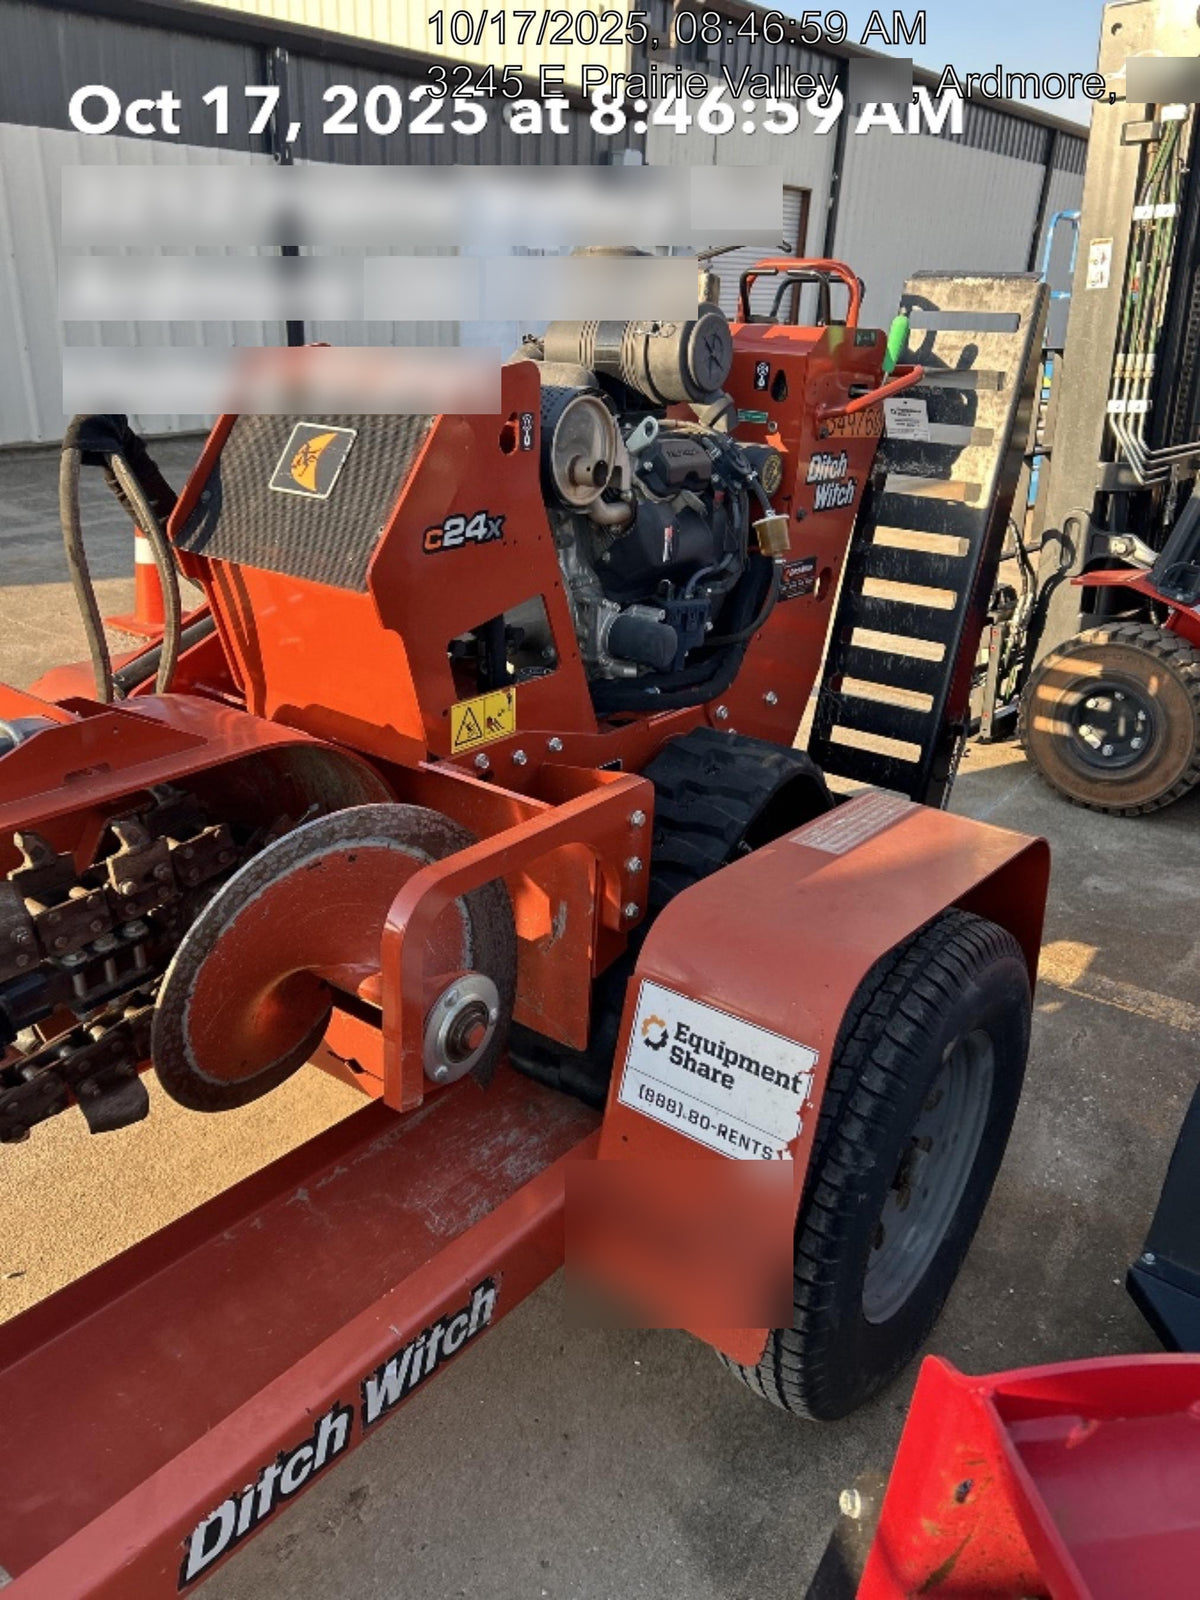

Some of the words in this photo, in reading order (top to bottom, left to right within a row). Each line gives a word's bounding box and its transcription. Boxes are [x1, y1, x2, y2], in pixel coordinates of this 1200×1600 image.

[807, 452, 847, 482] Ditch
[814, 479, 855, 510] Witch
[669, 1046, 735, 1090] Share
[673, 1021, 803, 1094] Equipment
[183, 1408, 351, 1584] Ditch
[363, 1281, 498, 1426] Witch
